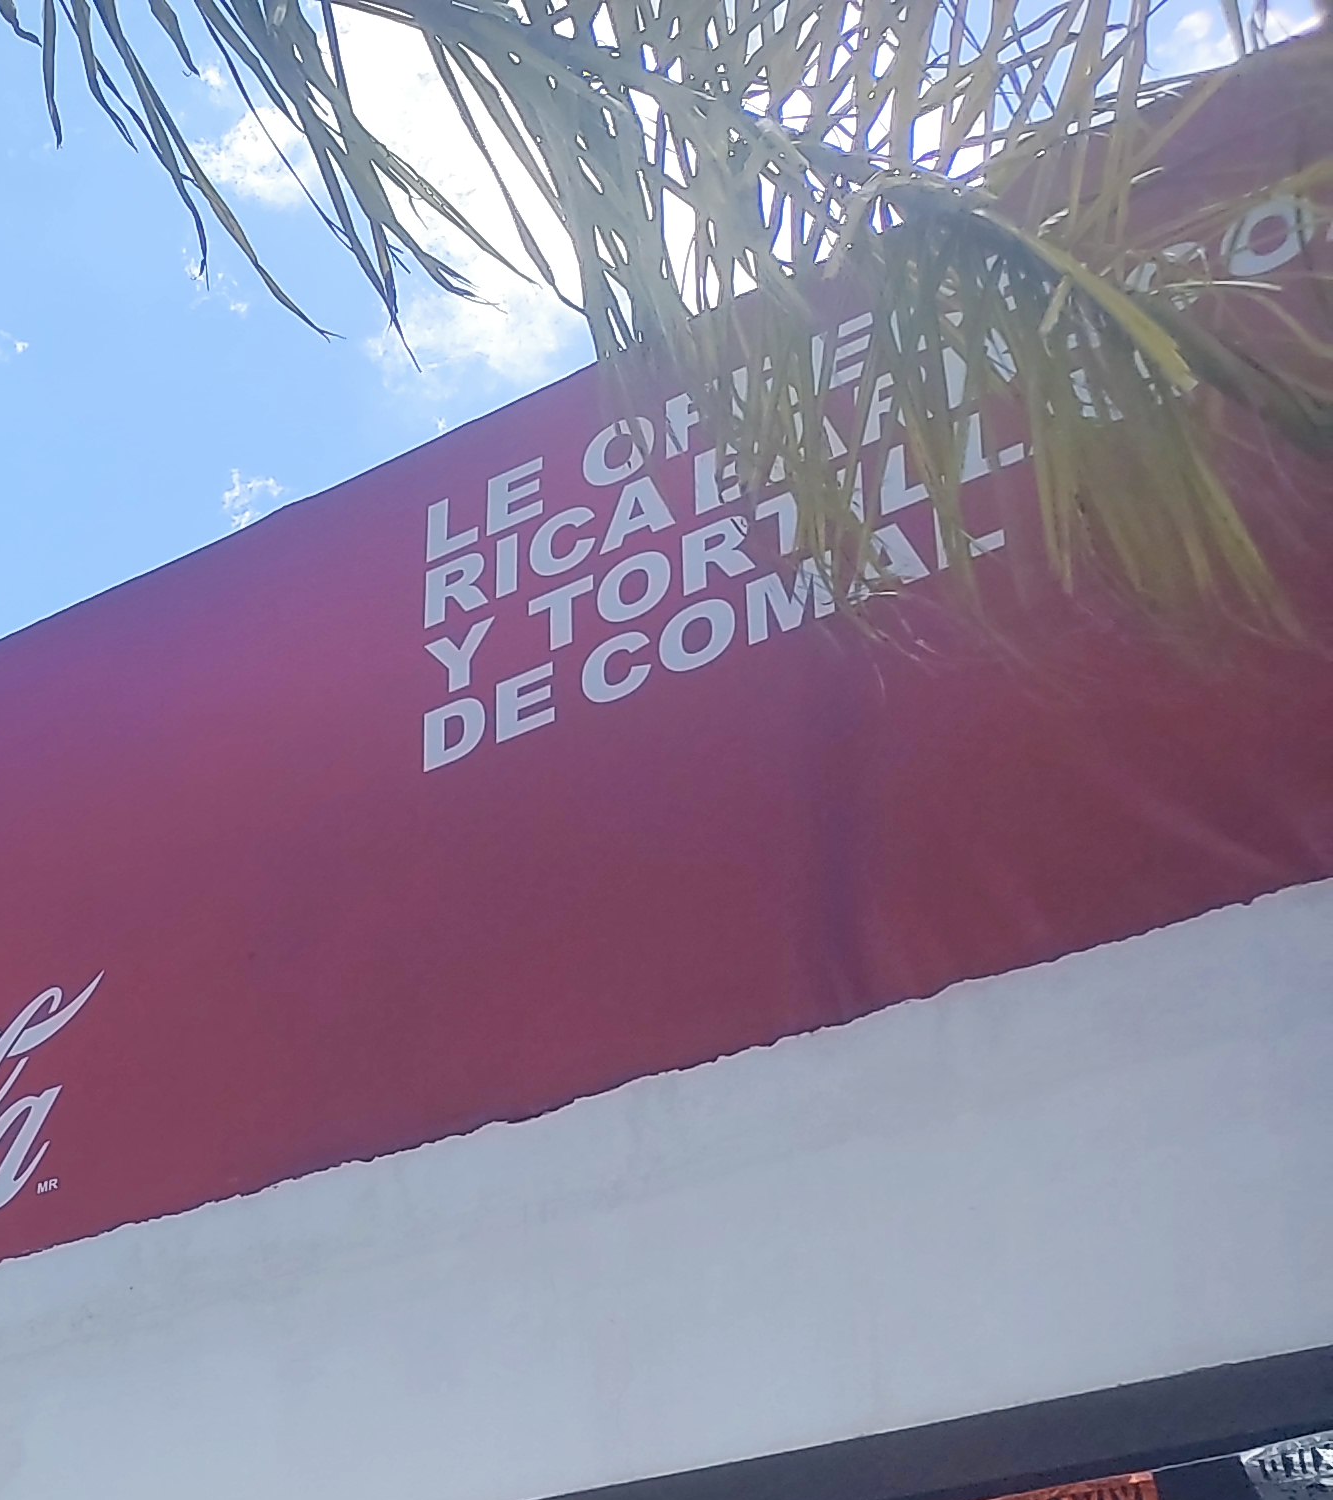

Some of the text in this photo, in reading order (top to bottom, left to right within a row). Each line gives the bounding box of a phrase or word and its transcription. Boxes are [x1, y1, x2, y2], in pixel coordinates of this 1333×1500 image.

[423, 477, 676, 628] RICA
[425, 455, 545, 563] LE
[425, 615, 496, 694] Y
[423, 662, 557, 773] DE
[35, 1177, 60, 1195] MR
